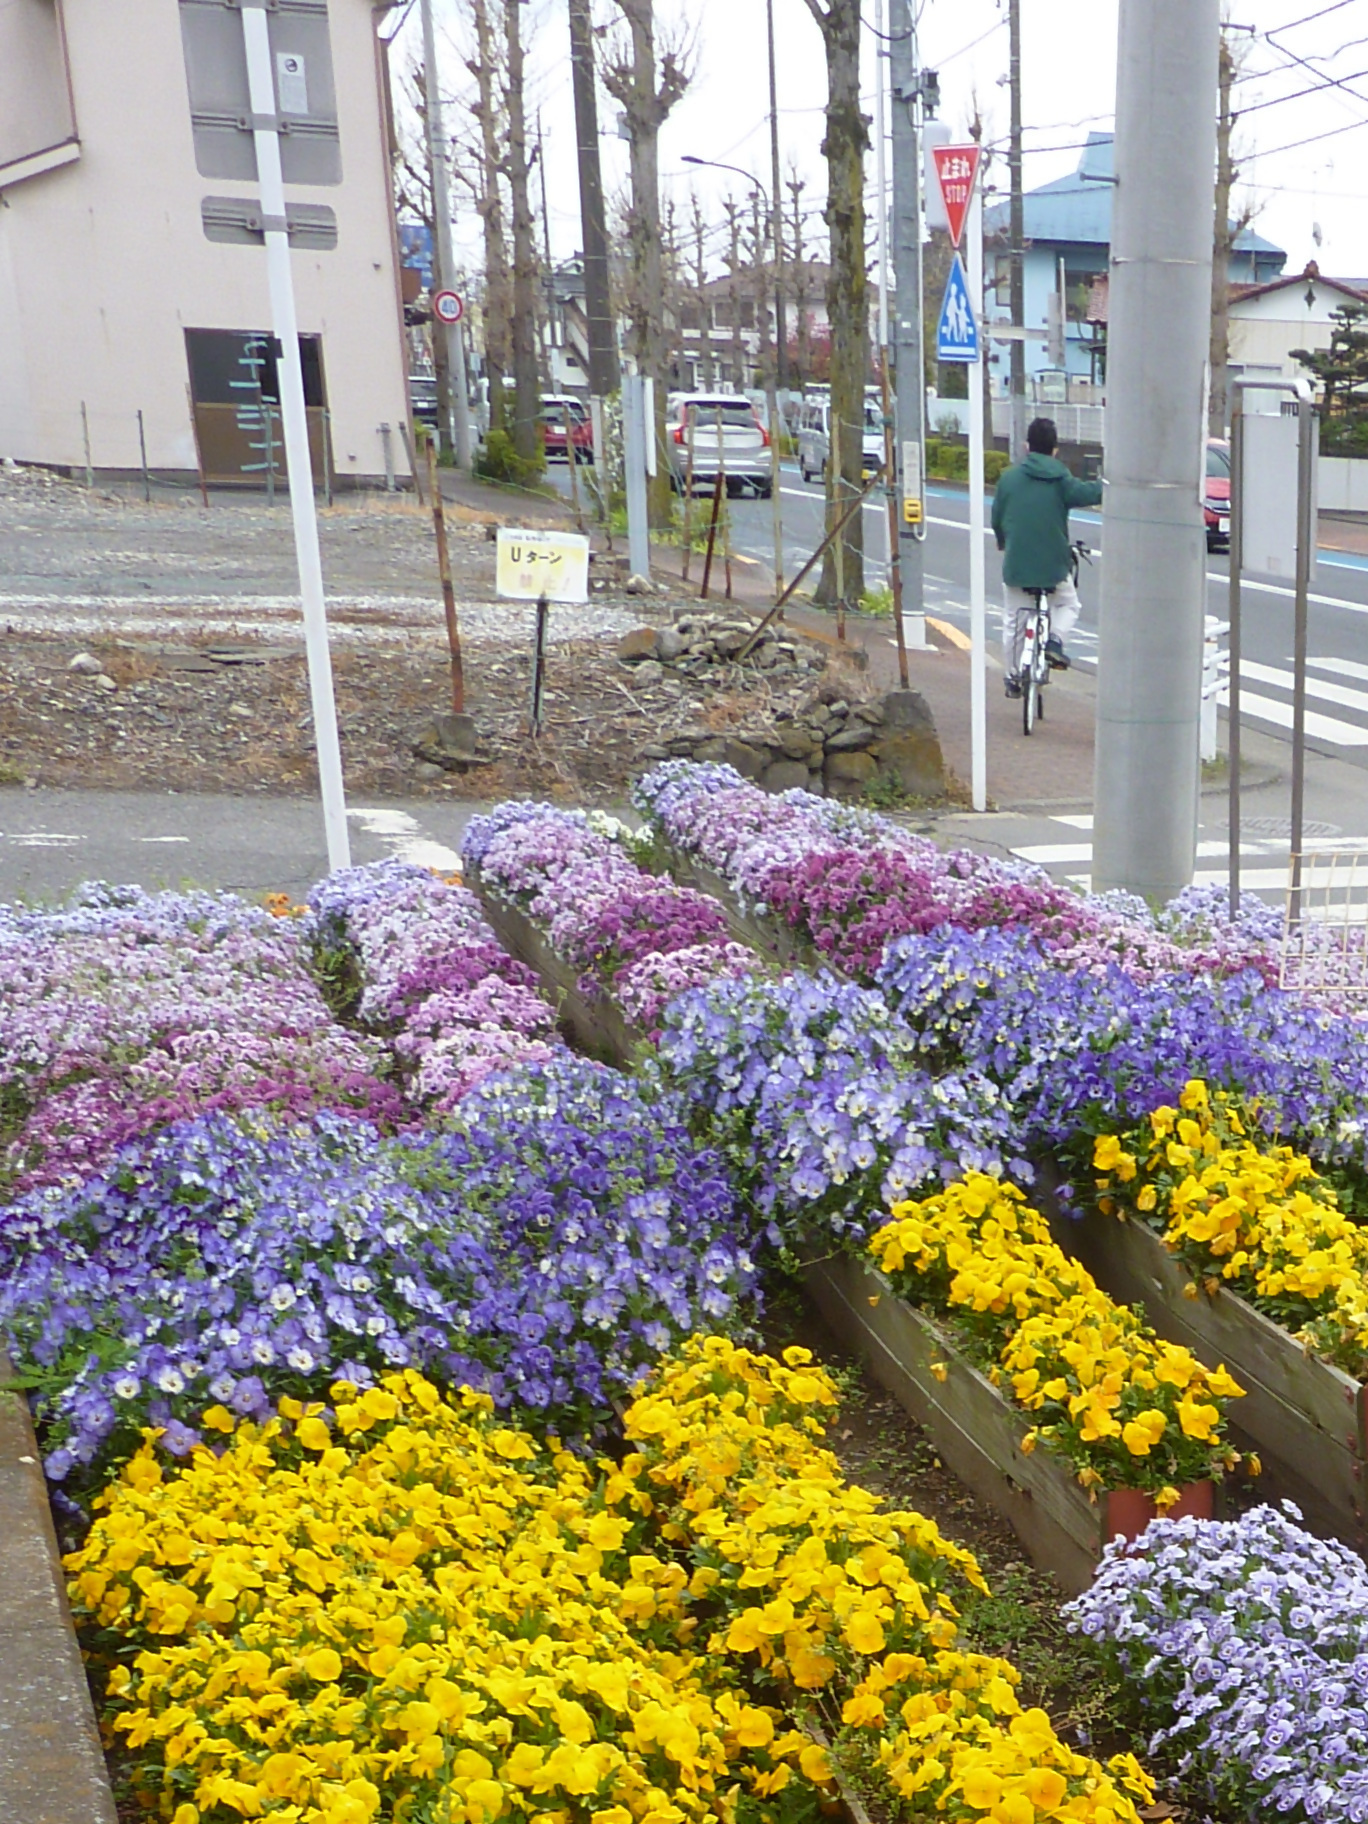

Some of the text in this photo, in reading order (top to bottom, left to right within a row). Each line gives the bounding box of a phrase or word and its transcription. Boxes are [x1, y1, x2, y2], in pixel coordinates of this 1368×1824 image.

[941, 155, 971, 180] 止まれ
[945, 184, 967, 204] STOP
[441, 299, 458, 314] 40
[511, 546, 562, 564] Uターン
